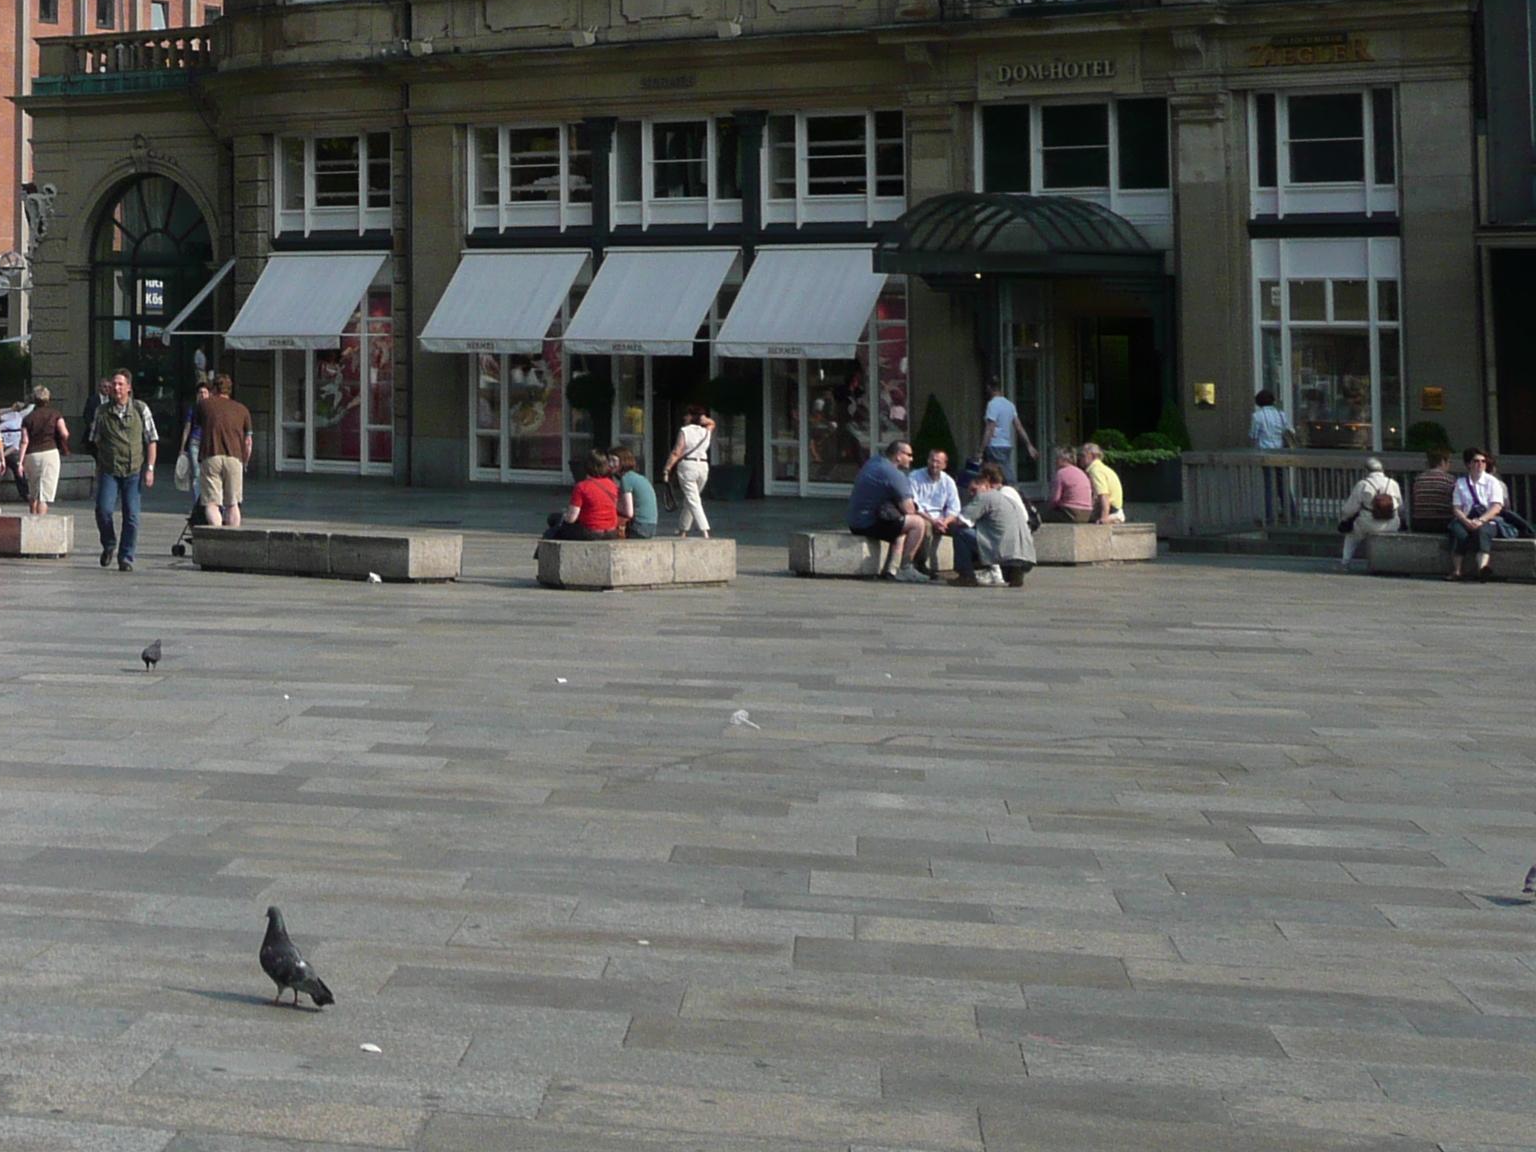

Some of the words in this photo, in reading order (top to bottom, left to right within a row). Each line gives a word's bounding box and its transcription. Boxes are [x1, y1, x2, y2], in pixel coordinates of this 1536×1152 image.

[1246, 36, 1375, 66] ZIEGLER
[997, 59, 1115, 83] DOM-HOTEL
[145, 292, 163, 304] Kös
